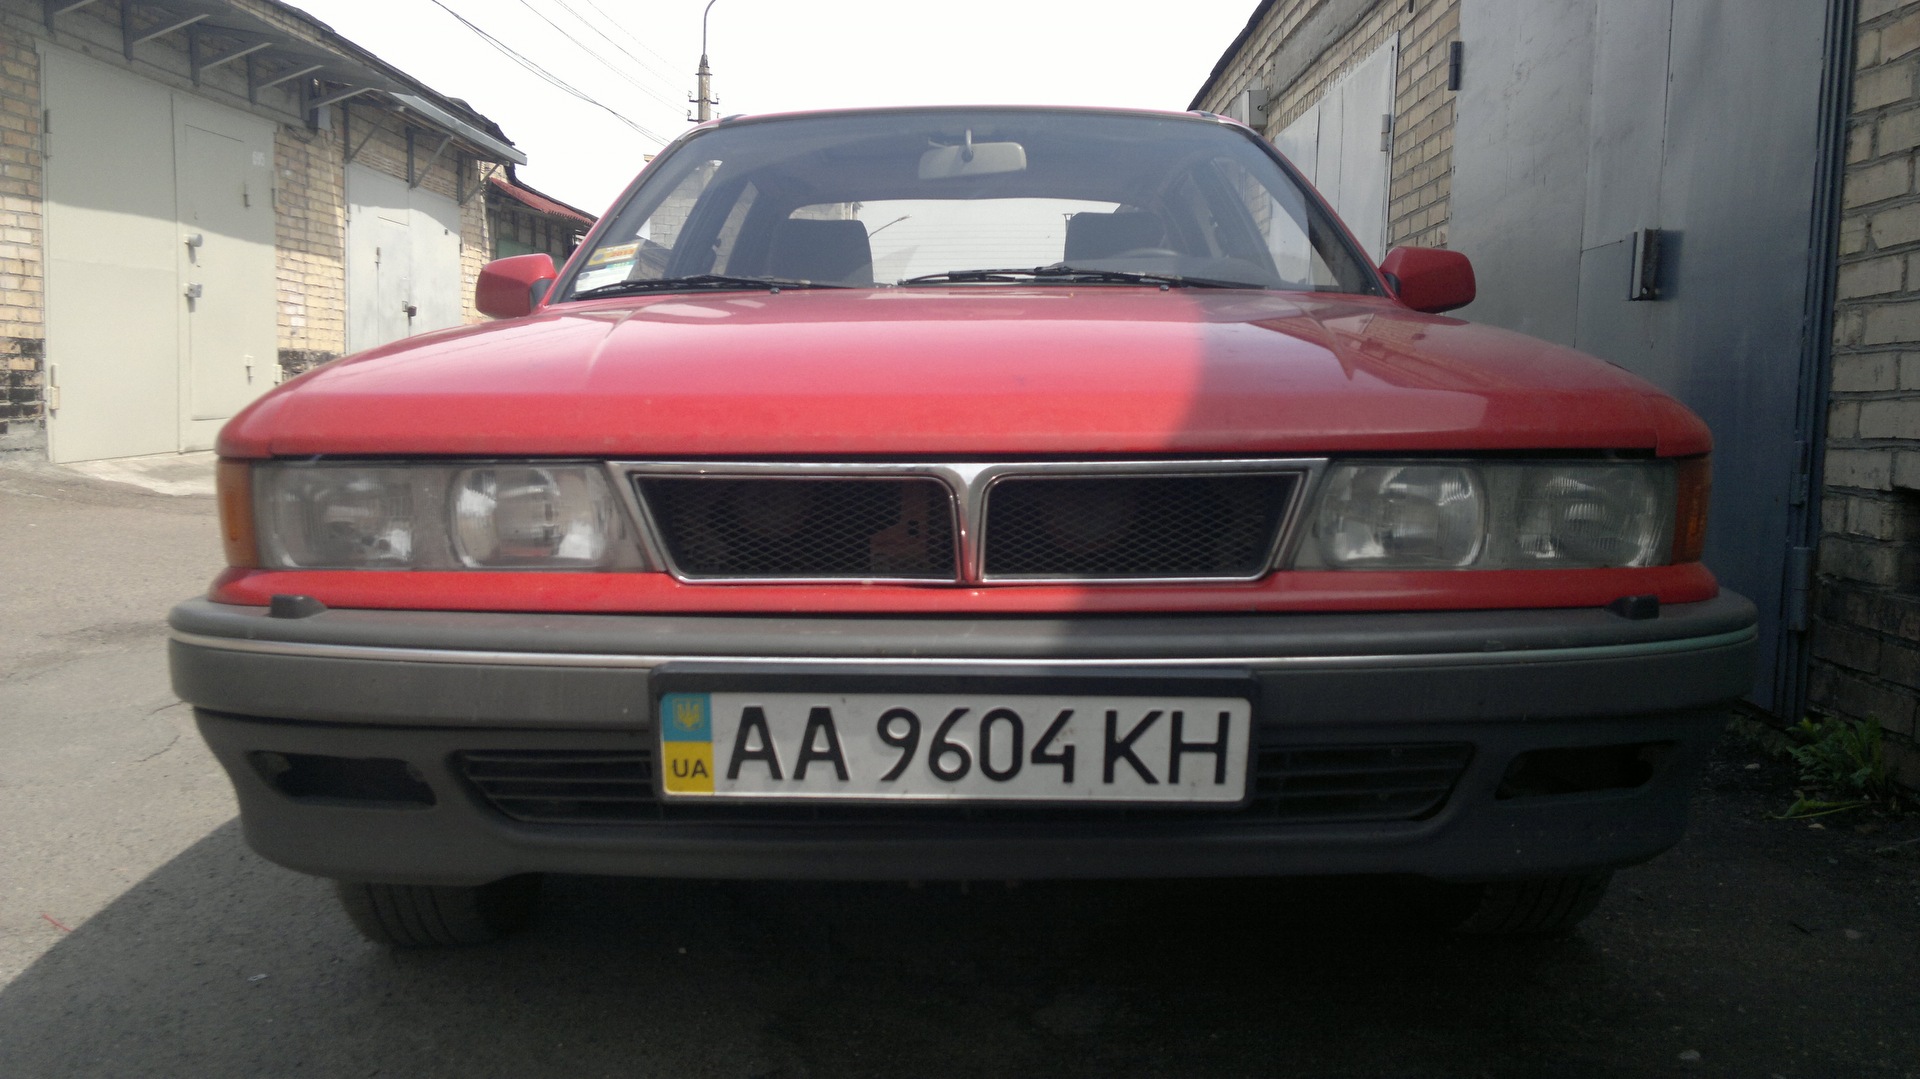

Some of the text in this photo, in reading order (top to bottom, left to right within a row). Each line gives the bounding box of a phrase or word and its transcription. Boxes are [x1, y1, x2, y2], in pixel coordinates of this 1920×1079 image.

[673, 759, 709, 778] UA
[726, 706, 1232, 786] AA 9604 KH
